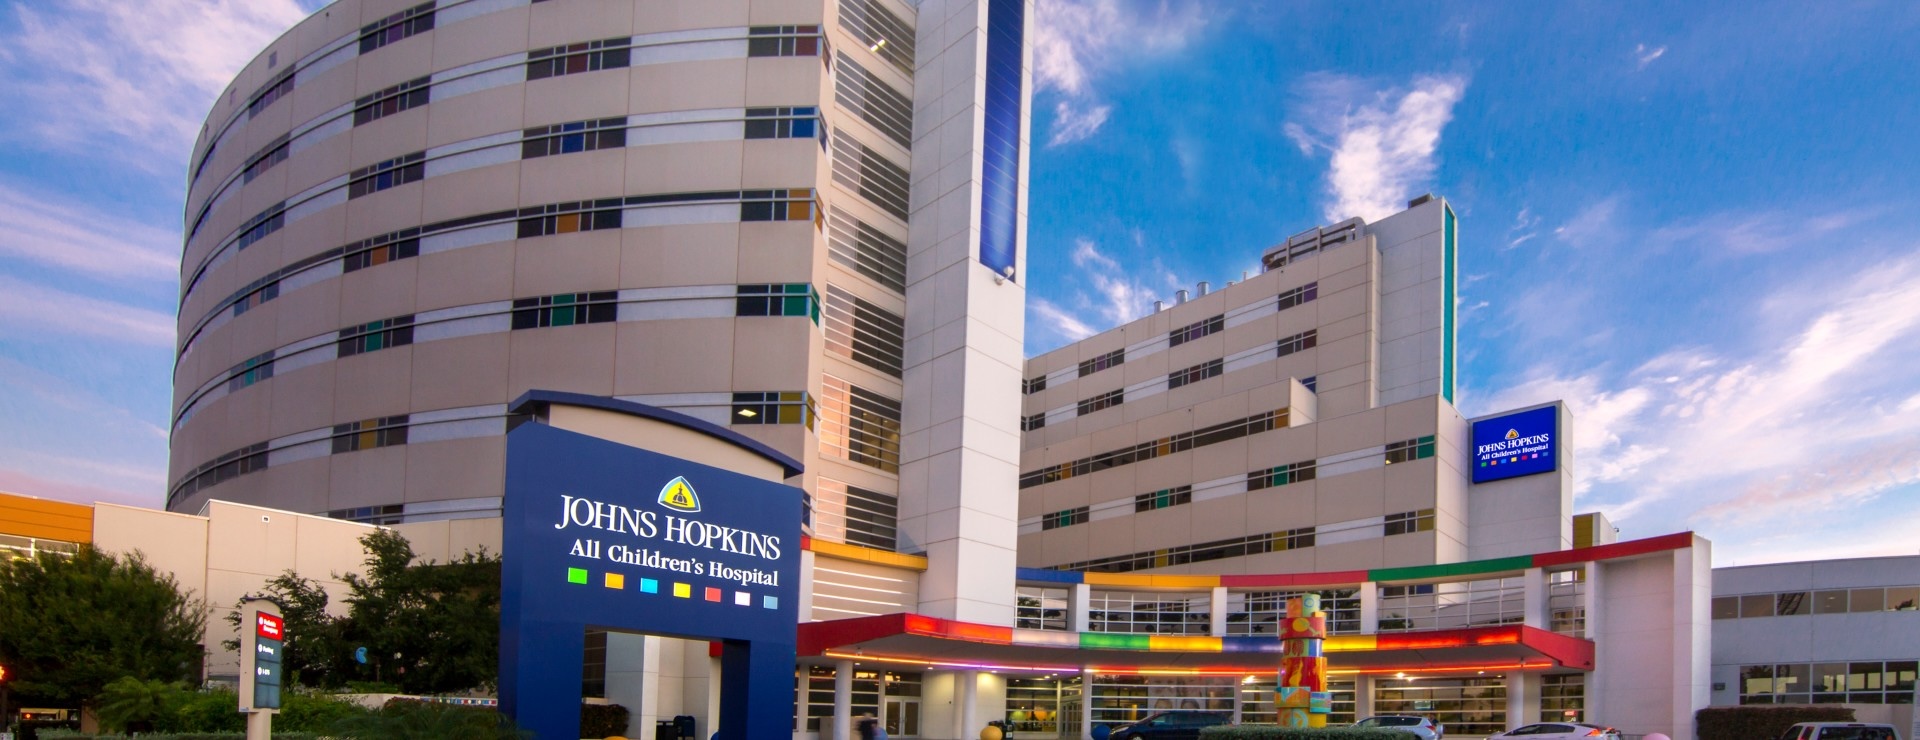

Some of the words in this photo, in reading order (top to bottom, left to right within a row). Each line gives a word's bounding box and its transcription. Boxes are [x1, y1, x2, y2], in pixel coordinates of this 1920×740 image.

[1477, 441, 1506, 456] JOHNS
[1507, 434, 1549, 447] HOPKINS
[1491, 449, 1521, 459] Children's
[1522, 443, 1549, 453] Hospital
[555, 495, 657, 538] JOHNS
[664, 515, 780, 560] HOPKINS
[569, 538, 601, 559] All
[608, 545, 703, 575] Children's
[708, 562, 778, 587] Hospital
